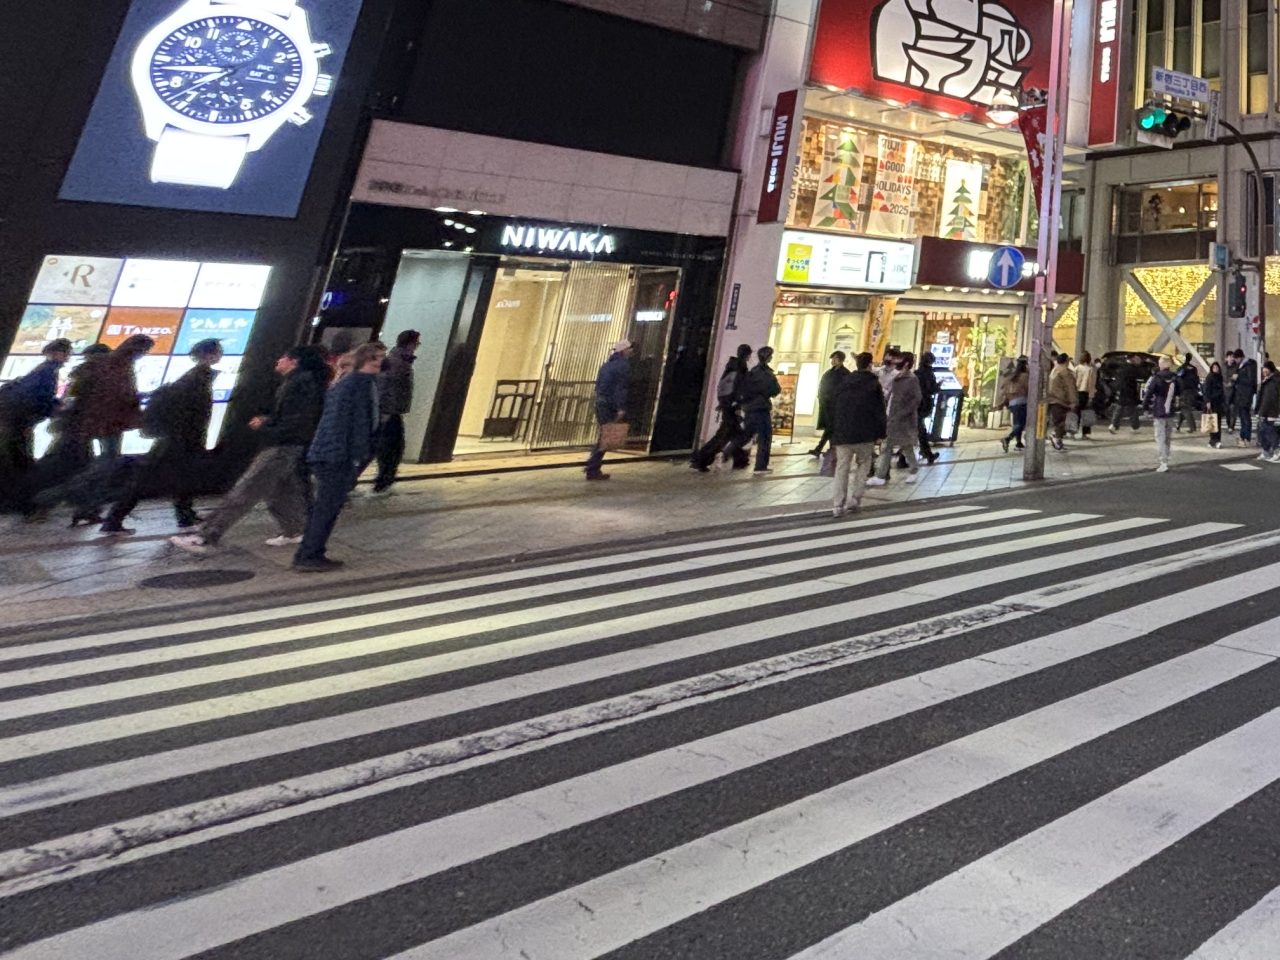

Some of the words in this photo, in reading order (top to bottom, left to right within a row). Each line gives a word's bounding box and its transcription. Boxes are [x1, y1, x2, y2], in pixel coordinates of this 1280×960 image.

[771, 115, 788, 157] MUJI
[885, 161, 906, 173] GOOD
[889, 204, 910, 216] 2025
[501, 224, 614, 254] NIWAKA
